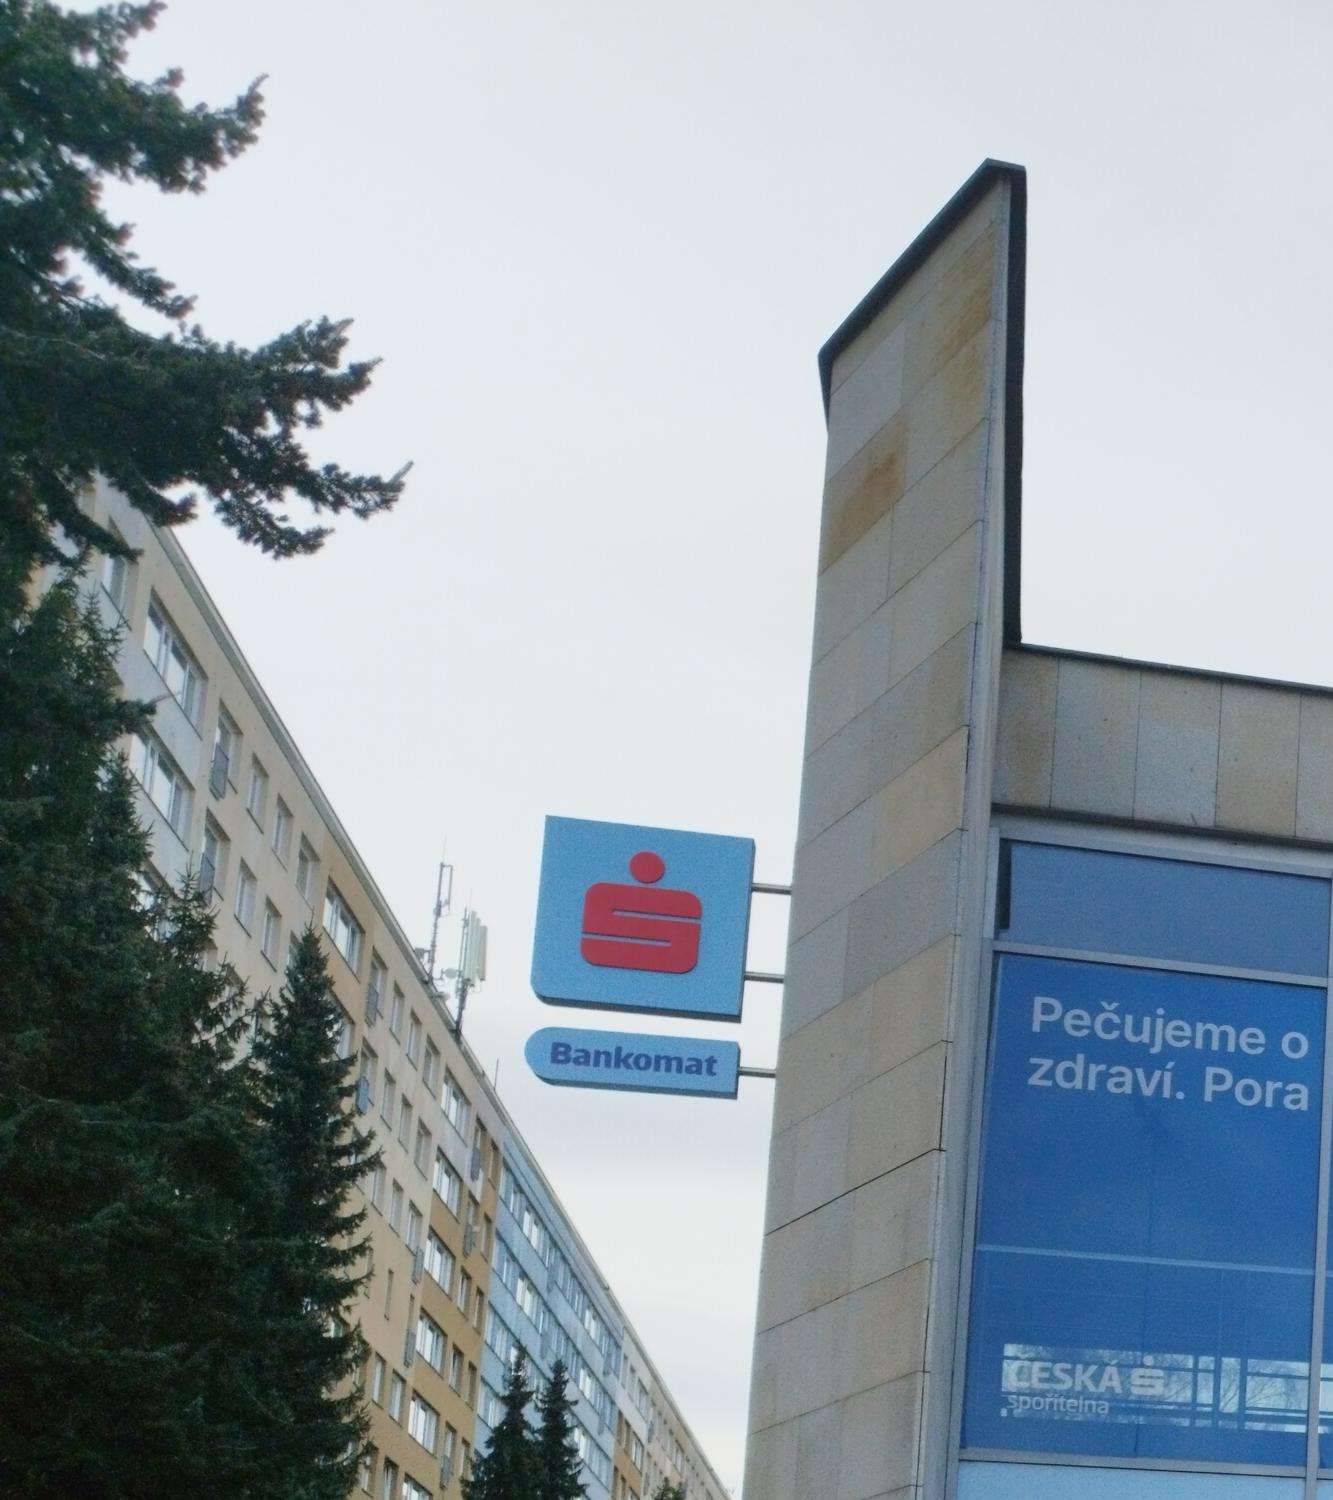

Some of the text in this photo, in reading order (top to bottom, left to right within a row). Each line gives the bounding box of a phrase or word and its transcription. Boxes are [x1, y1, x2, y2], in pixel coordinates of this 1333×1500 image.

[1030, 996, 1266, 1055] Pečujeme
[1281, 1030, 1309, 1059] o
[550, 1041, 718, 1077] Bankomat
[1027, 1054, 1186, 1101] zdraví.
[1005, 1354, 1121, 1394] ČESKÁ
[1006, 1394, 1110, 1416] spořitelna
